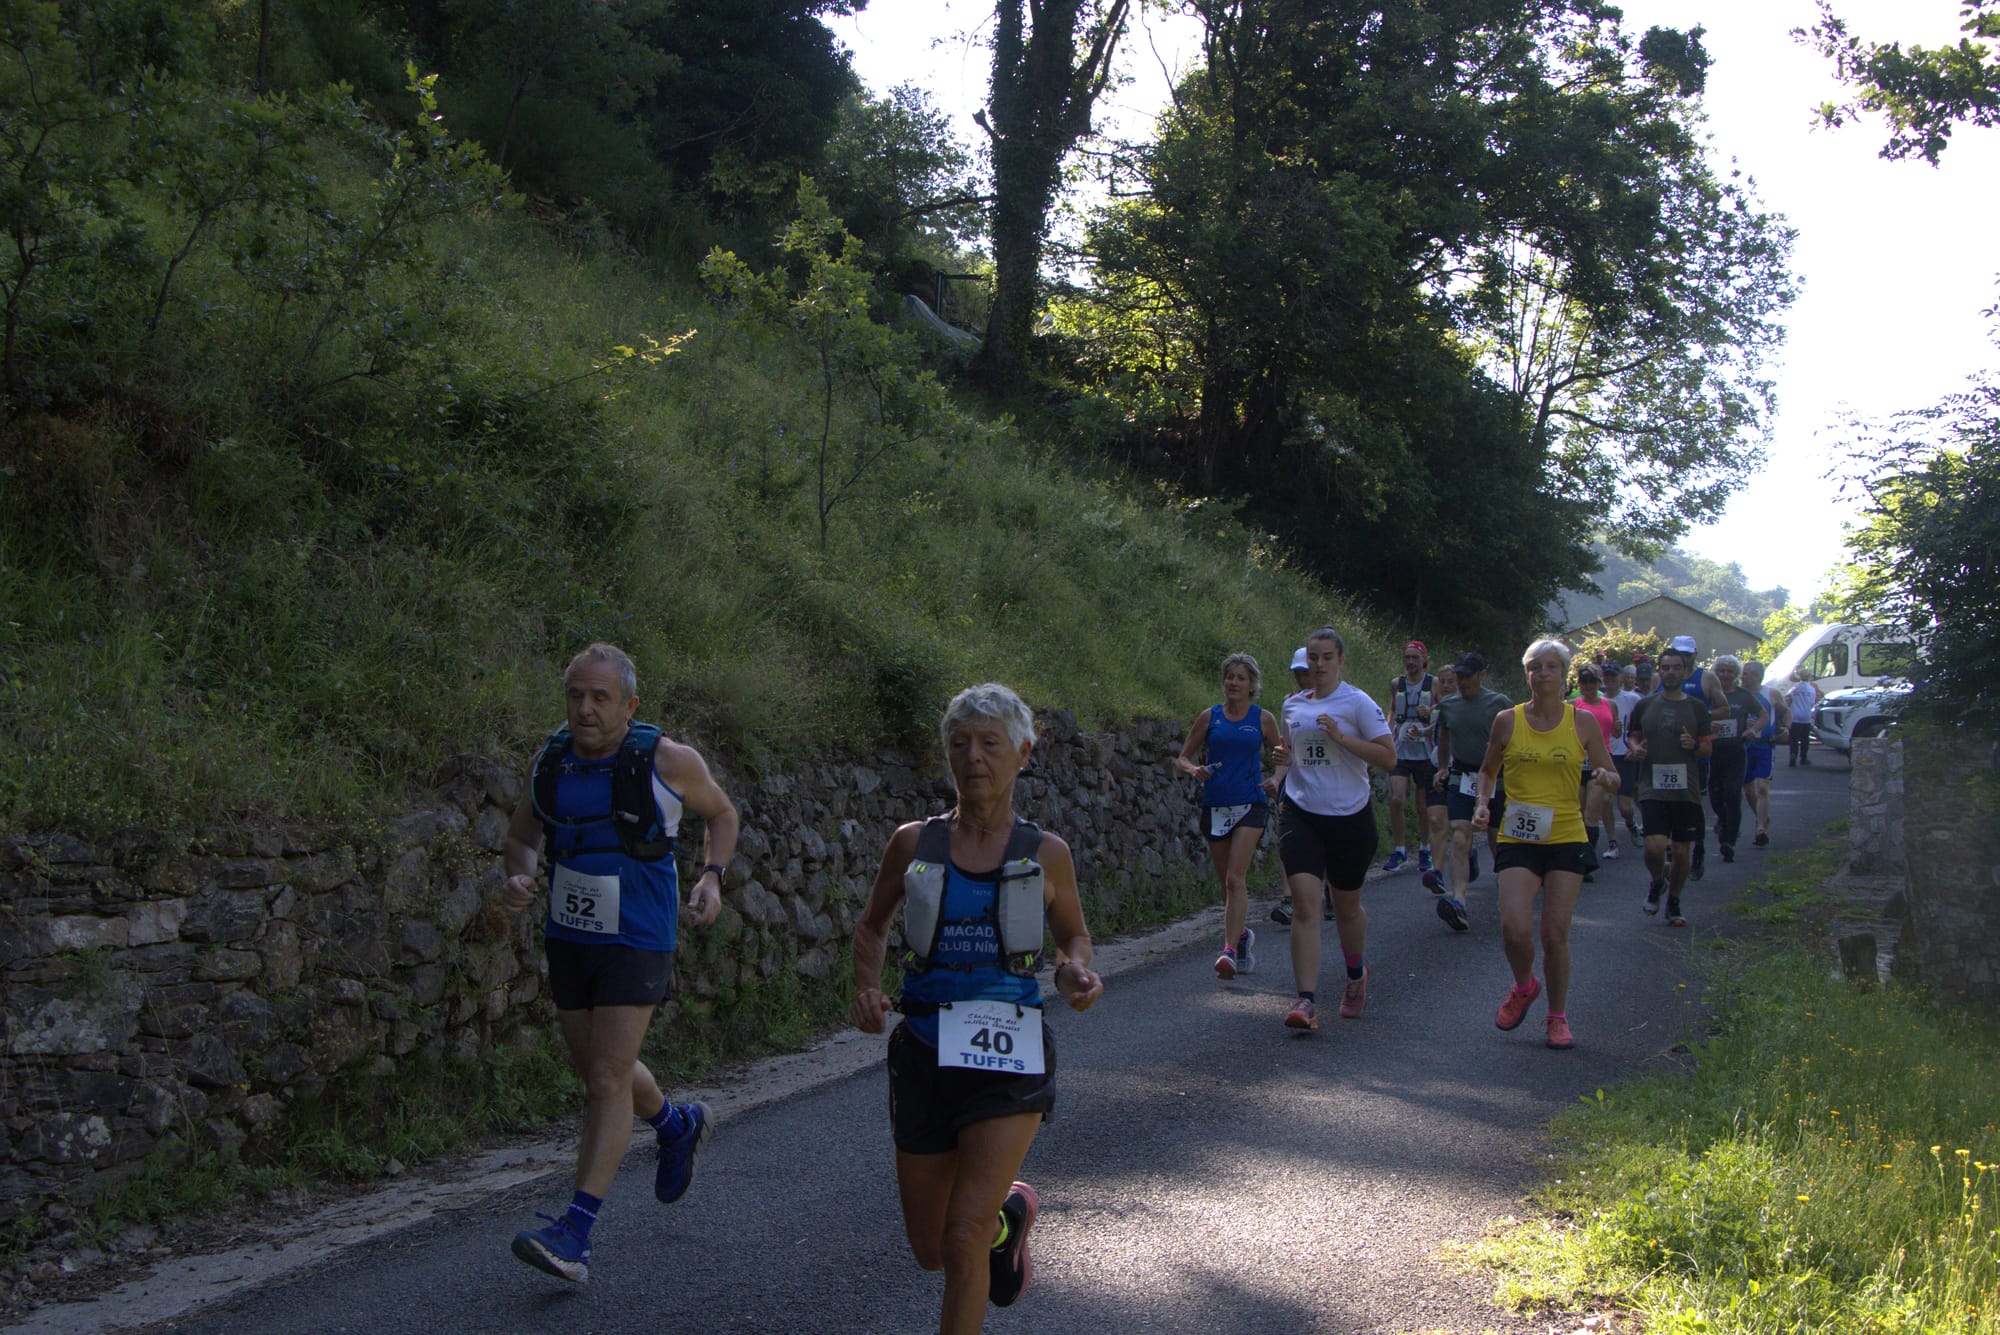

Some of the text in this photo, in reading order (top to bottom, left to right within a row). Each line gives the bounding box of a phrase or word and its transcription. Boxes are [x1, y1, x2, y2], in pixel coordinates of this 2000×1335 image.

[1307, 746, 1325, 758] 18
[1663, 774, 1678, 783] 78
[1516, 816, 1536, 832] 35
[1511, 829, 1541, 840] TUFF'S
[565, 893, 595, 918] 52
[559, 911, 604, 931] TUFF'S
[937, 940, 972, 952] CLUB
[970, 1027, 1014, 1055] 40
[960, 1052, 1025, 1071] TUFF'S
